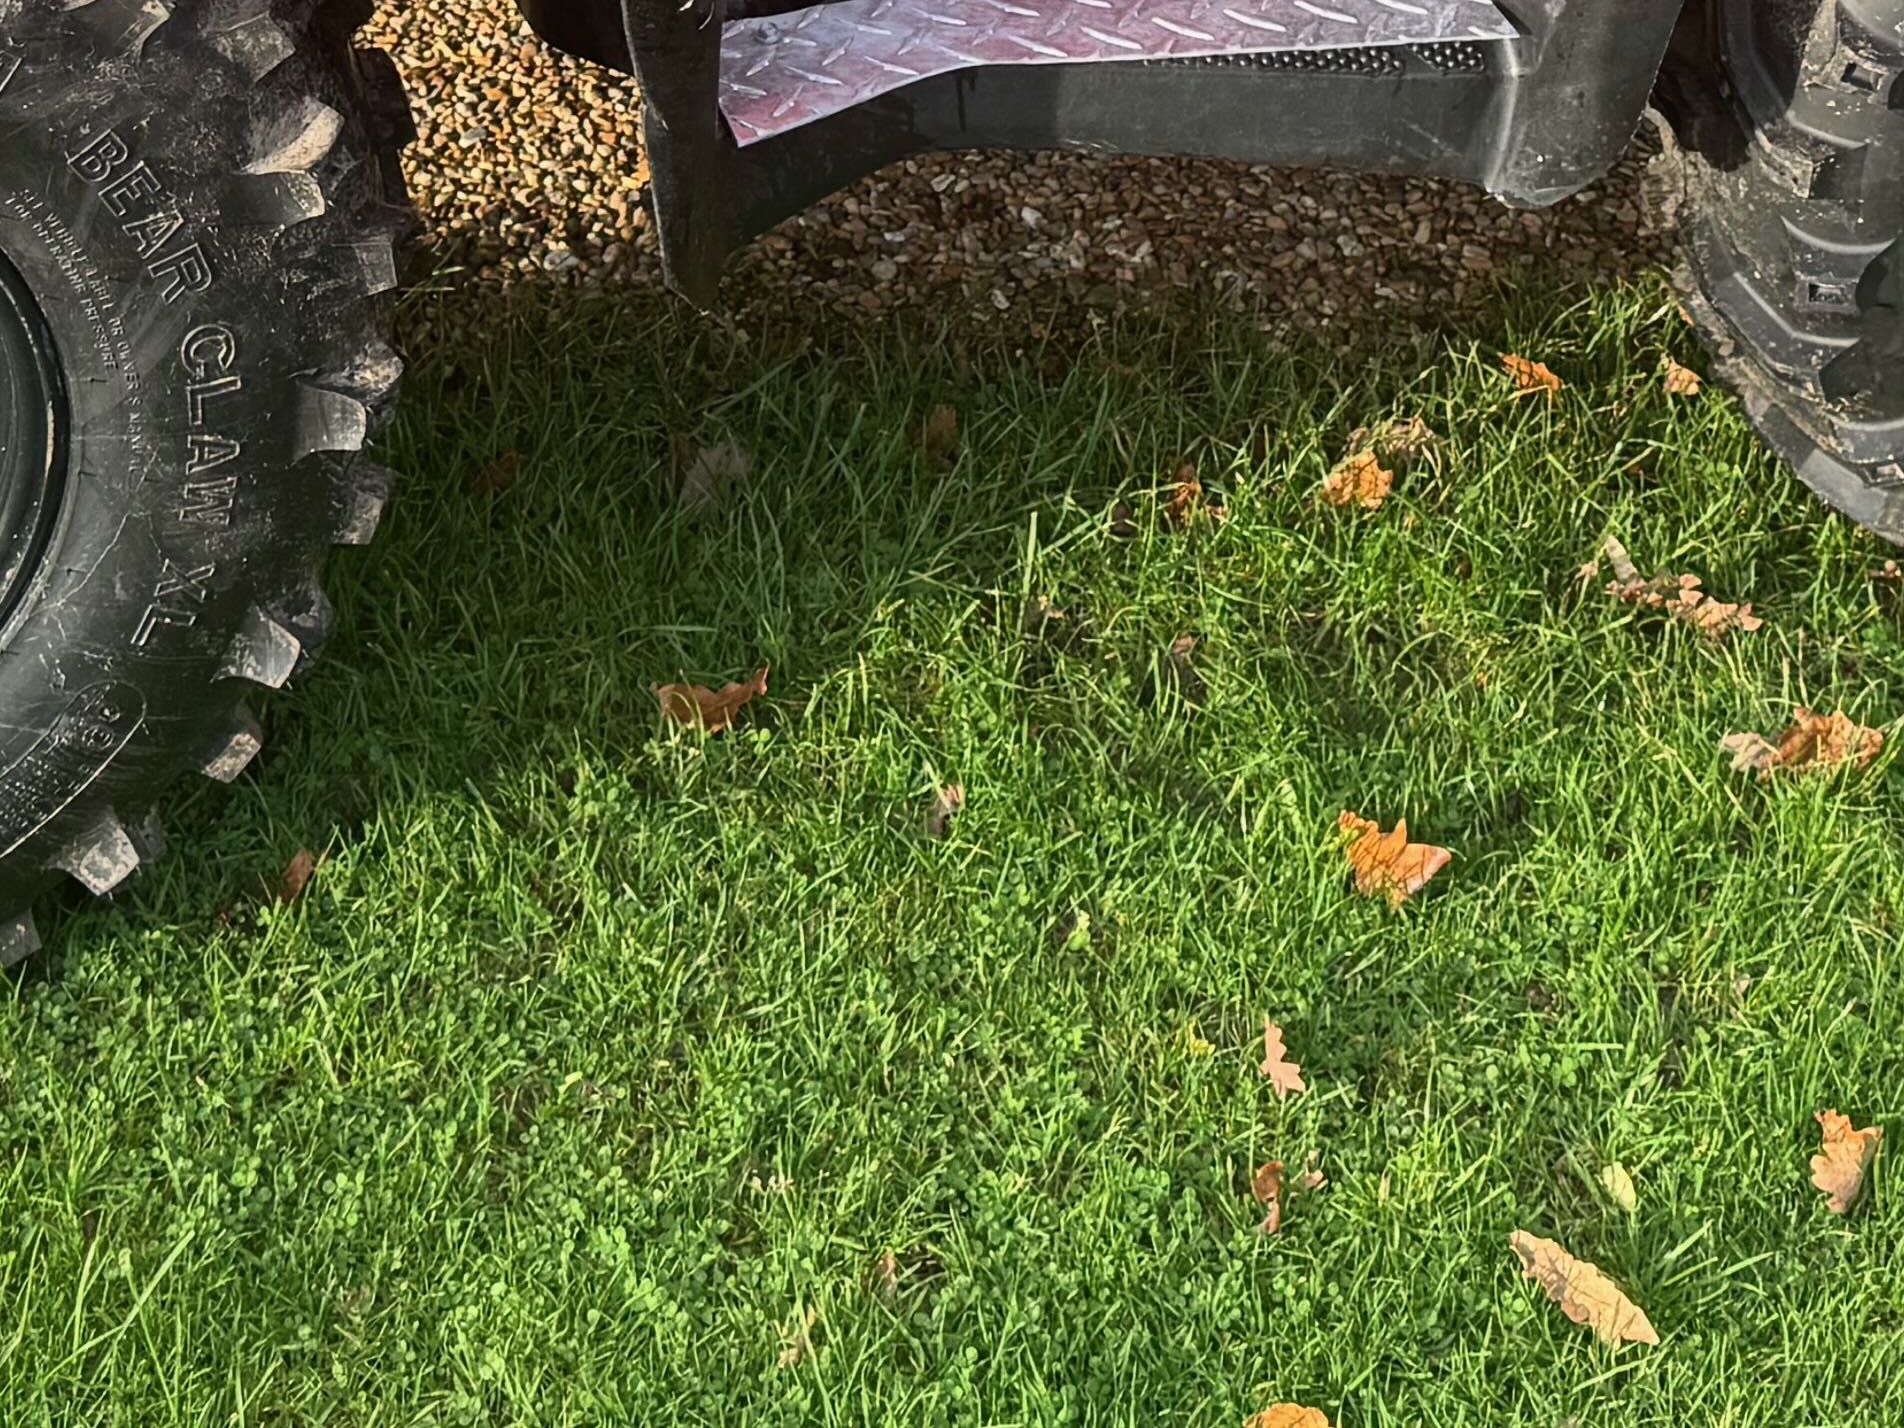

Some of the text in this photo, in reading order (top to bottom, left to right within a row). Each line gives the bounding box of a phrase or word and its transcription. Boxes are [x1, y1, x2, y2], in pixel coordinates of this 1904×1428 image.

[65, 129, 242, 646] BEAR CLAW XL
